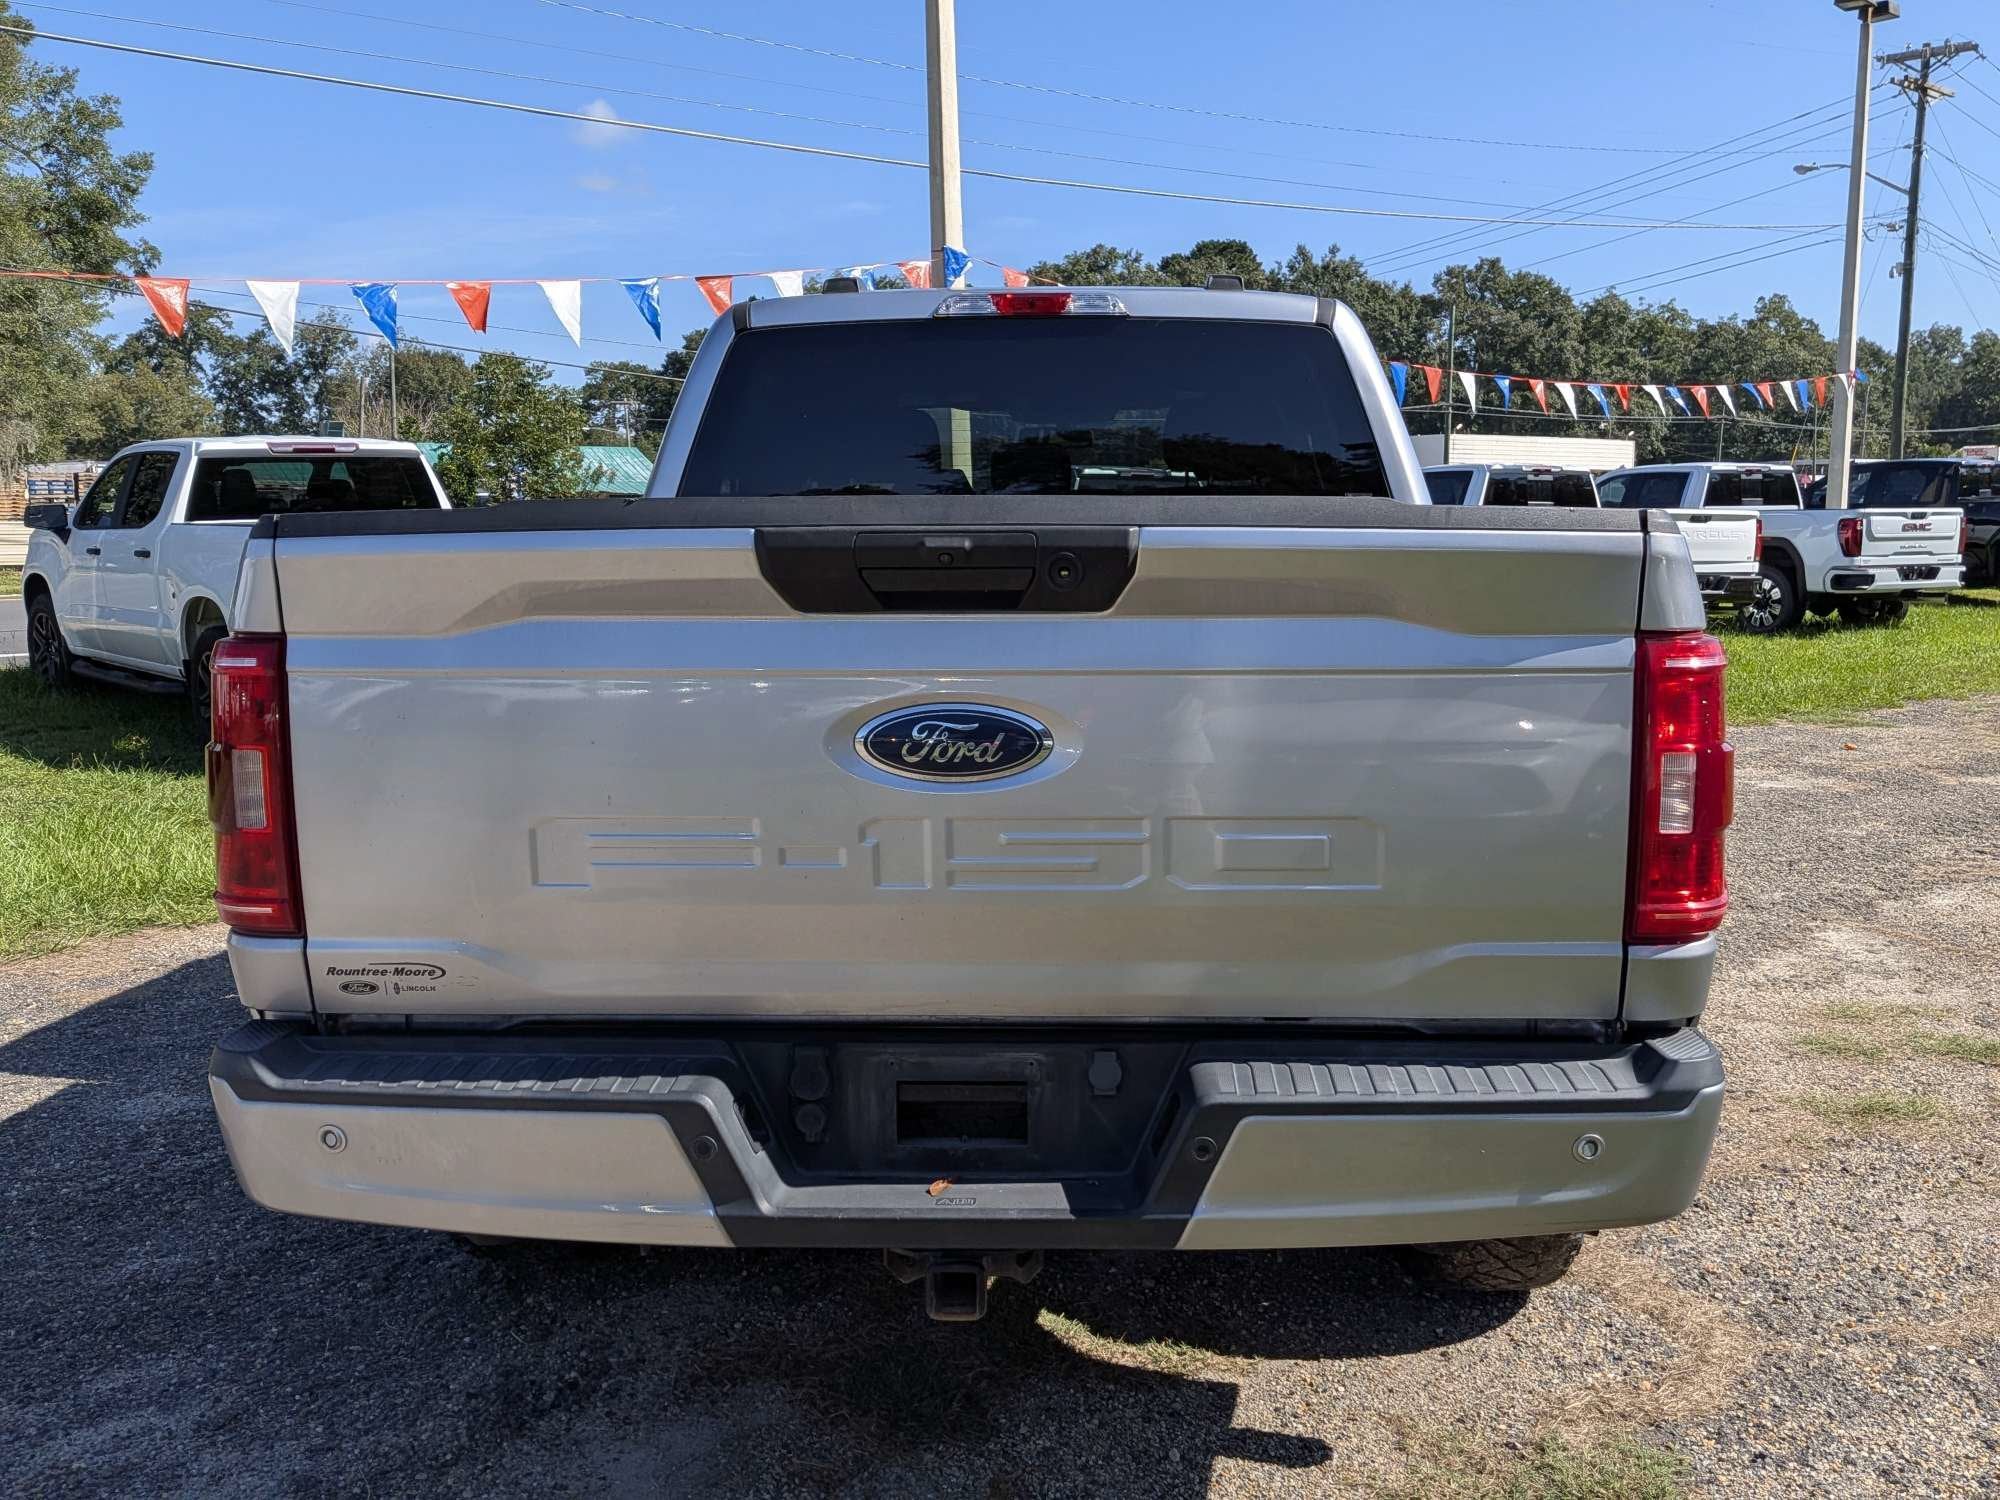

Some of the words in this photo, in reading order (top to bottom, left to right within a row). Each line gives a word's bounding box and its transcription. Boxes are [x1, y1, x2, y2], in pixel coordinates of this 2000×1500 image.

[1901, 522, 1932, 533] GMC
[901, 720, 1005, 764] Ford
[530, 816, 1387, 891] F-150
